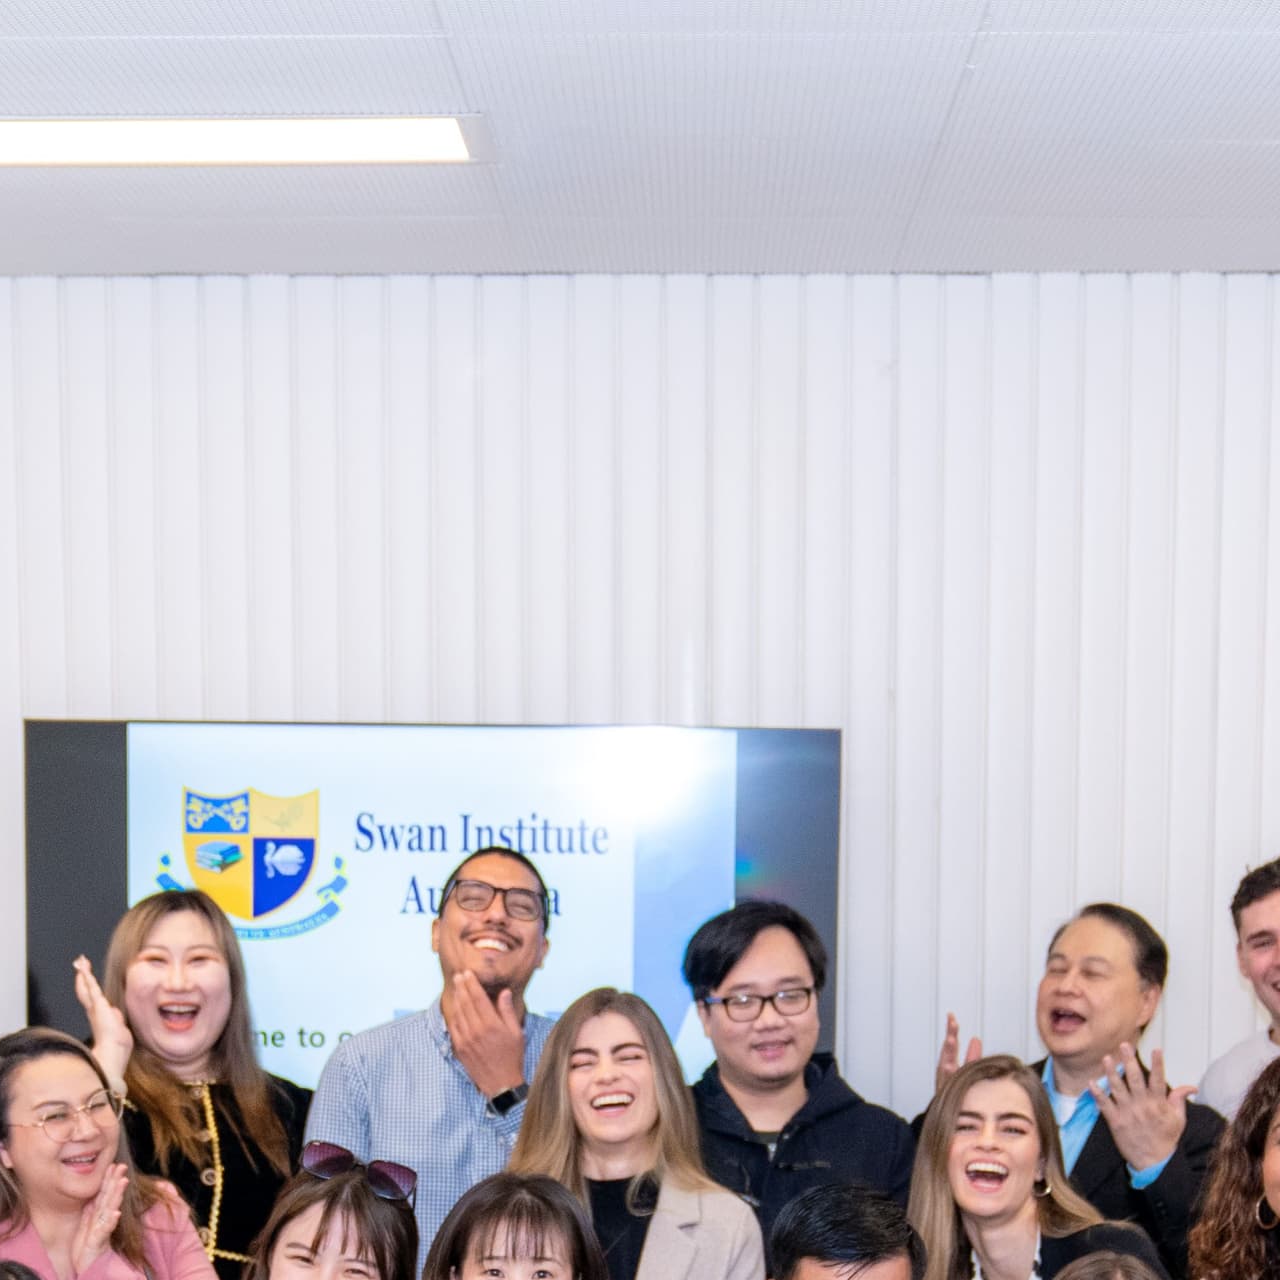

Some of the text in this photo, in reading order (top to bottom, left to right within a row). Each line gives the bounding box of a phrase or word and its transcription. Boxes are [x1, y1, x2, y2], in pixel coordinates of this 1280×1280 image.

[355, 811, 609, 855] Swan Institute
[298, 1026, 325, 1048] to
